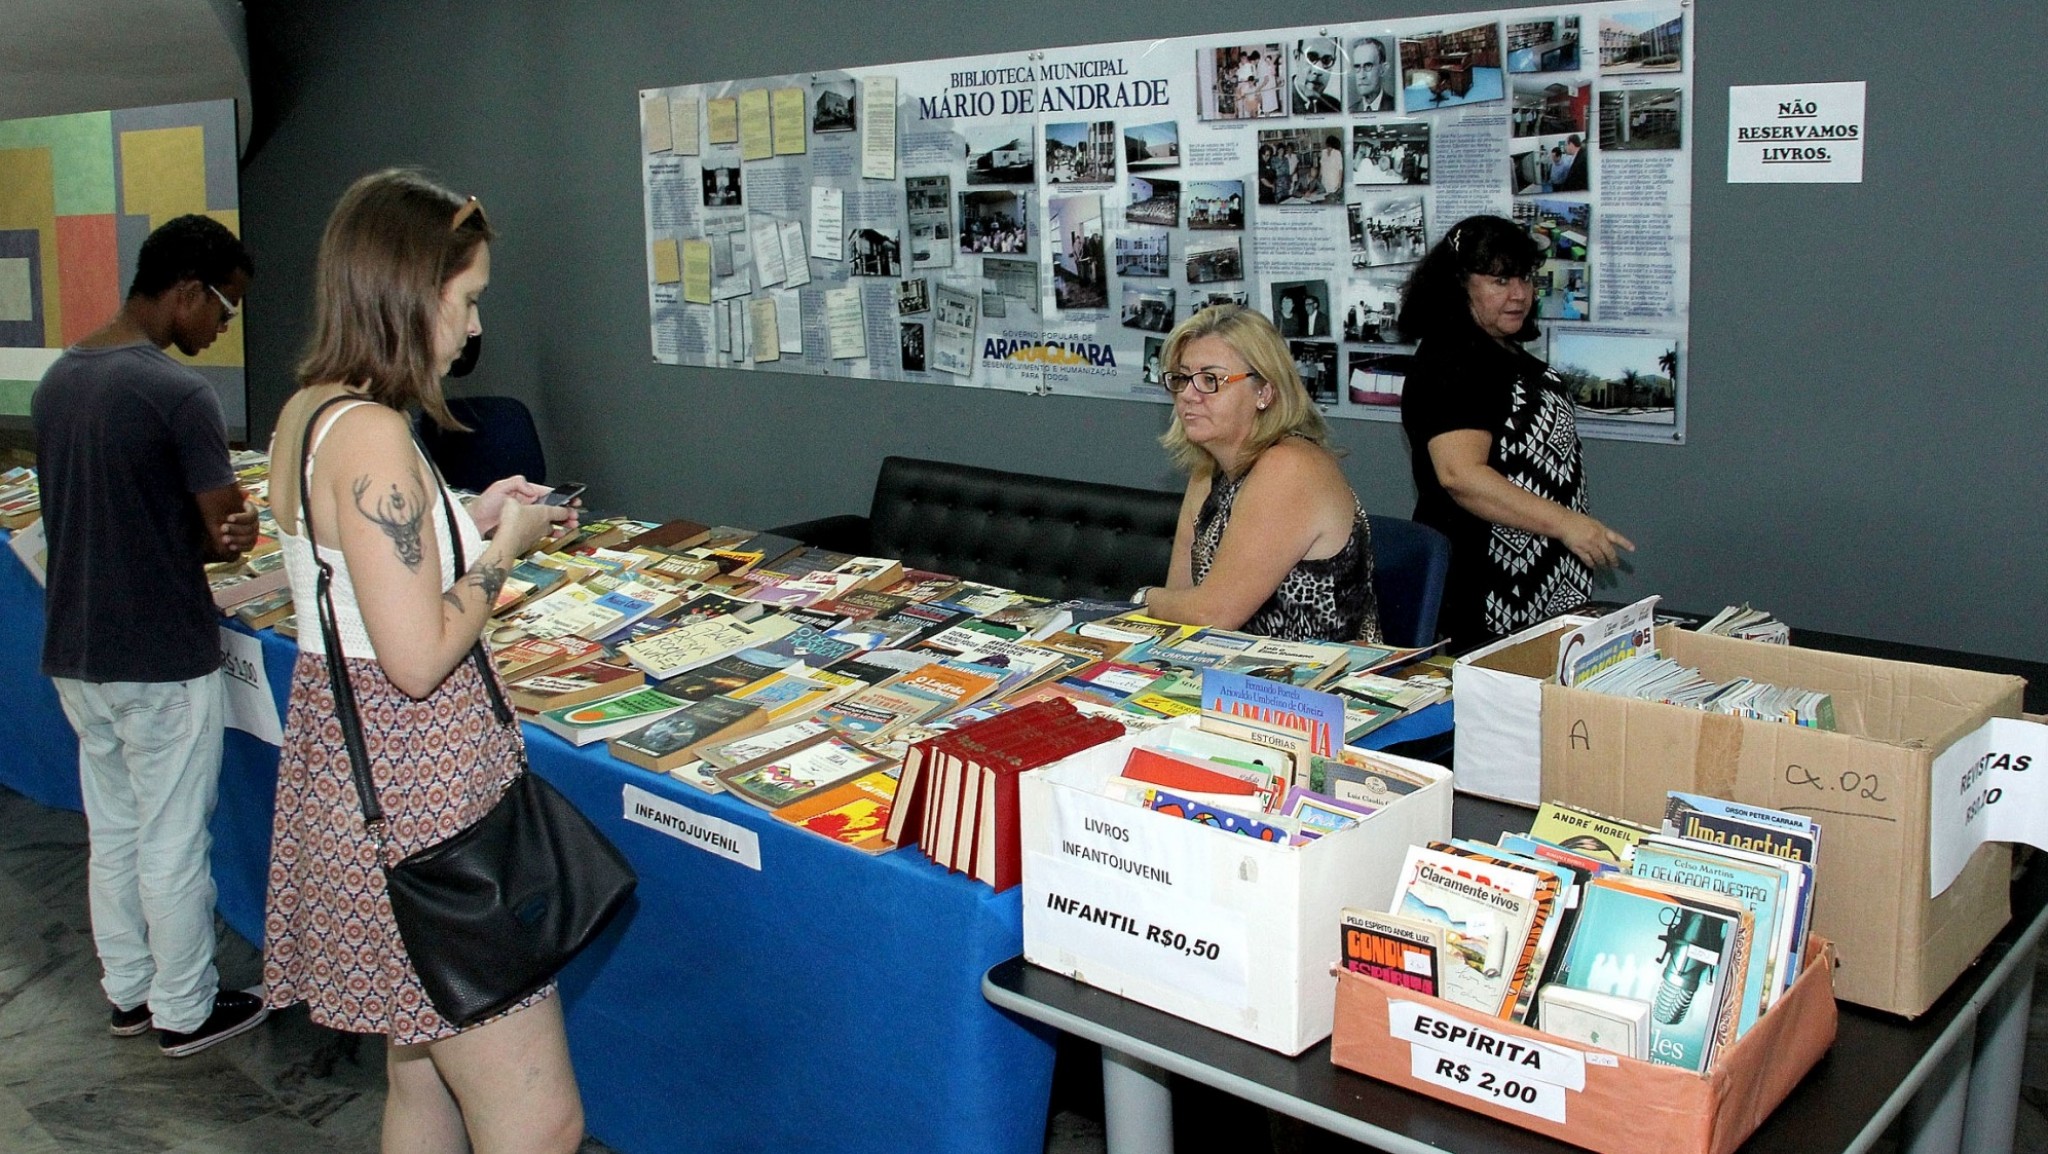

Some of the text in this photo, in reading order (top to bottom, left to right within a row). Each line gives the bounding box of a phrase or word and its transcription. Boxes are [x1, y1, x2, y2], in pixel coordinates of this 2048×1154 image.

[950, 58, 1128, 88] BIBLIOTECA MUNICIPAL
[918, 79, 1170, 120] MÁRIO DE ANDRADE
[1778, 98, 1818, 118] NÃO
[1738, 124, 1859, 143] RESERVAMOS
[1762, 147, 1832, 163] LIVROS.
[1002, 330, 1093, 342] GOVERNO POPULAR DE
[983, 338, 1117, 367] ARARAQUARA
[982, 360, 1050, 372] DESENVOLVIMENTO
[1061, 365, 1118, 377] HUMANIZAÇÃO
[1021, 371, 1069, 382] PARA TODOS
[1245, 678, 1276, 695] Fernando
[1287, 702, 1297, 712] de
[1251, 731, 1297, 751] ESTÓRIAS
[1568, 719, 1590, 750] A
[1959, 753, 2033, 796] REVISTAS
[634, 802, 740, 854] INFANTOJUVENIL
[1084, 816, 1130, 843] LIVROS
[1725, 806, 1804, 827] ORSON PETER CARRARA
[1593, 823, 1632, 842] MOREIL
[1062, 839, 1173, 886] INFANTOJUVENIL
[1674, 858, 1735, 879] Celso Martins
[1420, 866, 1488, 901] Claramente
[1491, 890, 1520, 912] vivos
[1638, 863, 1768, 902] A DELICADA QUESTÃO
[1047, 892, 1221, 961] INFANTIL R$0,50
[1346, 915, 1430, 944] PELO ESPÍRITO ANDRÉ LUIZ
[1347, 930, 1432, 971] CONDU
[1413, 1014, 1542, 1070] ESPÍRITA
[1435, 1057, 1538, 1104] R$ 2,00
